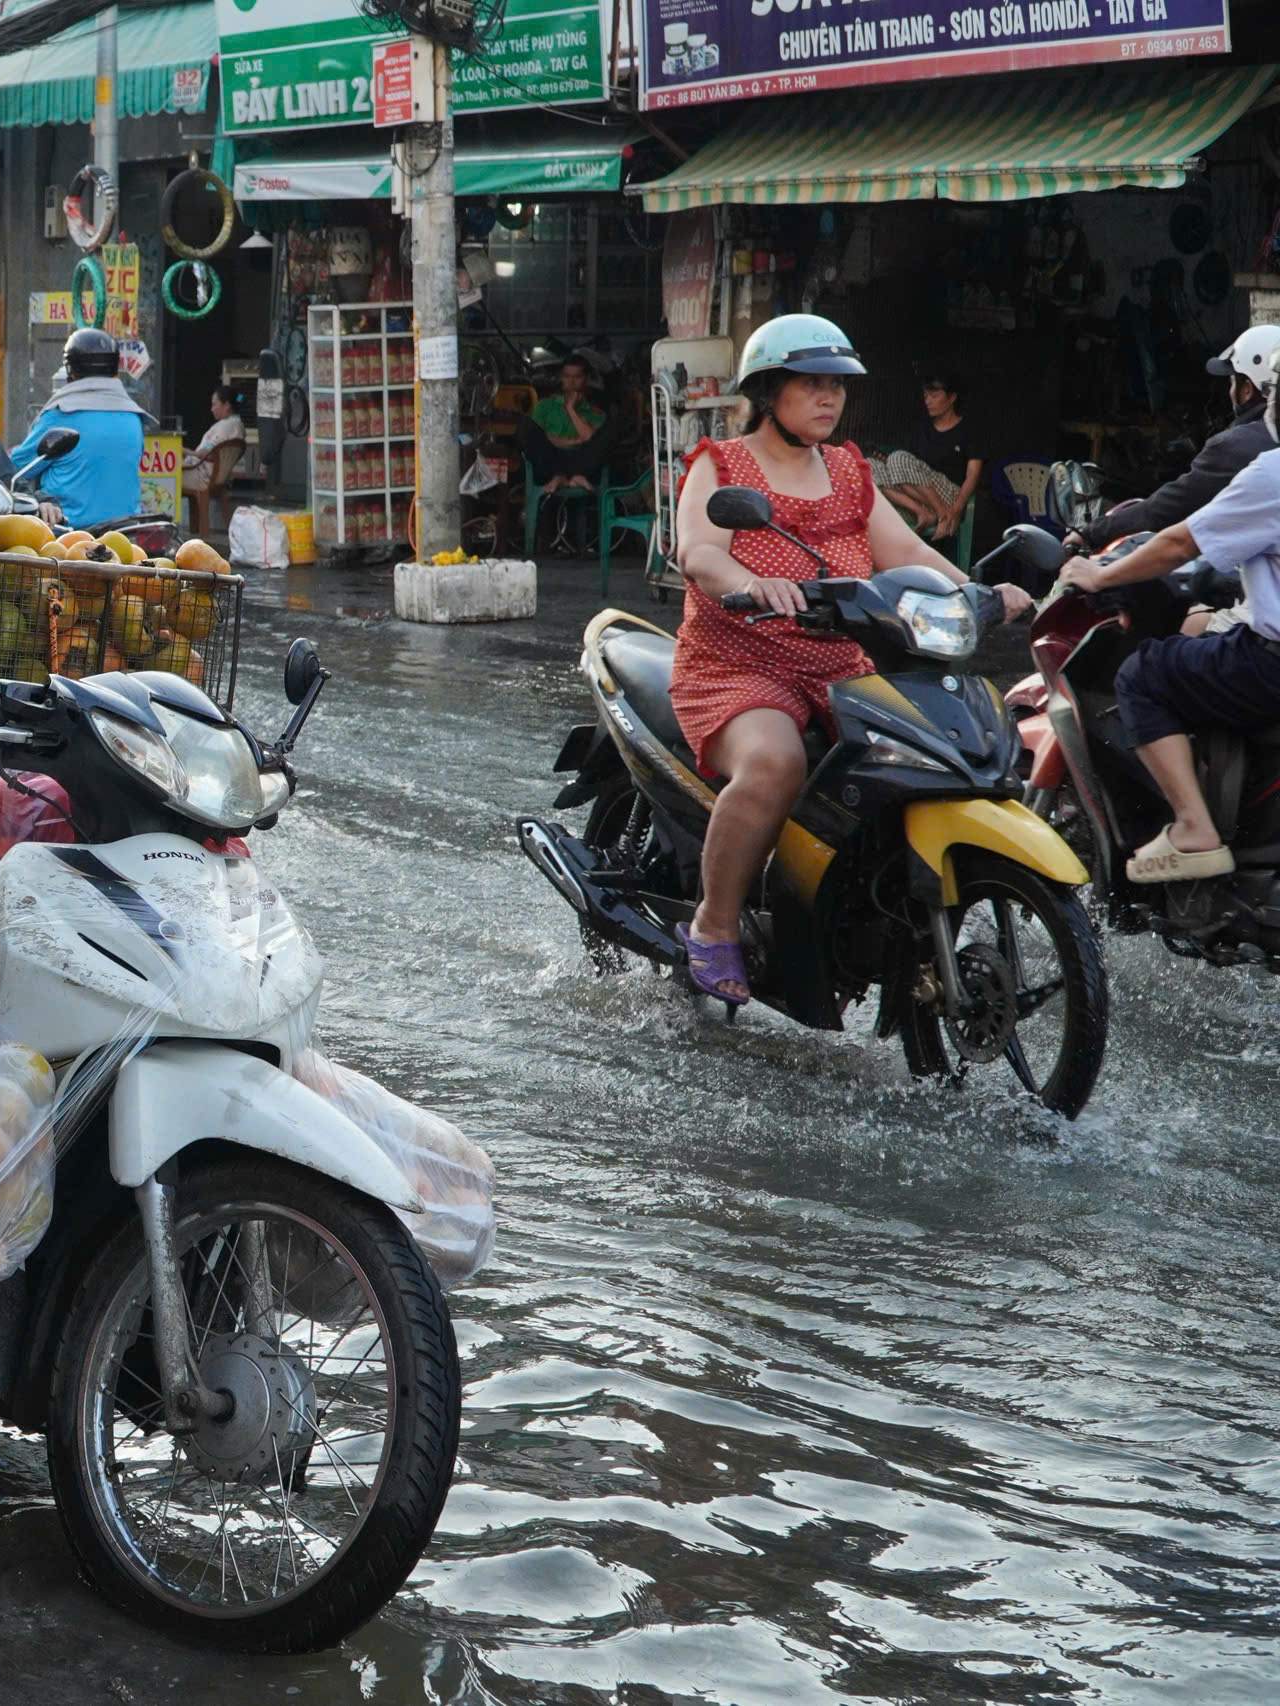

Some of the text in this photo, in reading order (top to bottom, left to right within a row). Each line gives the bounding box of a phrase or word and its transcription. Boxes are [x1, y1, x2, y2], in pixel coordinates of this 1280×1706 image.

[508, 33, 529, 53] THẾ
[531, 33, 554, 52] PHỤ
[555, 29, 587, 50] TÙNG
[779, 21, 841, 61] CHUYÊN
[844, 17, 877, 53] TÂN
[880, 13, 934, 49] TRANG
[950, 7, 986, 42] SƠN
[990, 0, 1025, 37] SỬA
[1029, 0, 1090, 33] HONDA
[1106, 0, 1135, 25] TAY
[1141, 0, 1168, 22] GA
[1147, 40, 1171, 54] 0934
[1176, 38, 1194, 52] 907
[1198, 35, 1218, 50] 463
[253, 59, 264, 73] XE
[462, 65, 487, 84] LOẠI
[504, 60, 543, 77] HONDA
[551, 57, 569, 72] TAY
[571, 55, 588, 70] GA
[730, 84, 744, 97] BA
[794, 75, 817, 88] HCM
[232, 76, 279, 125] BẢY
[282, 78, 349, 120] LINH
[351, 76, 370, 112] 2
[258, 176, 291, 191] Castrol
[139, 440, 177, 473] CẢO
[141, 850, 206, 865] HONDA
